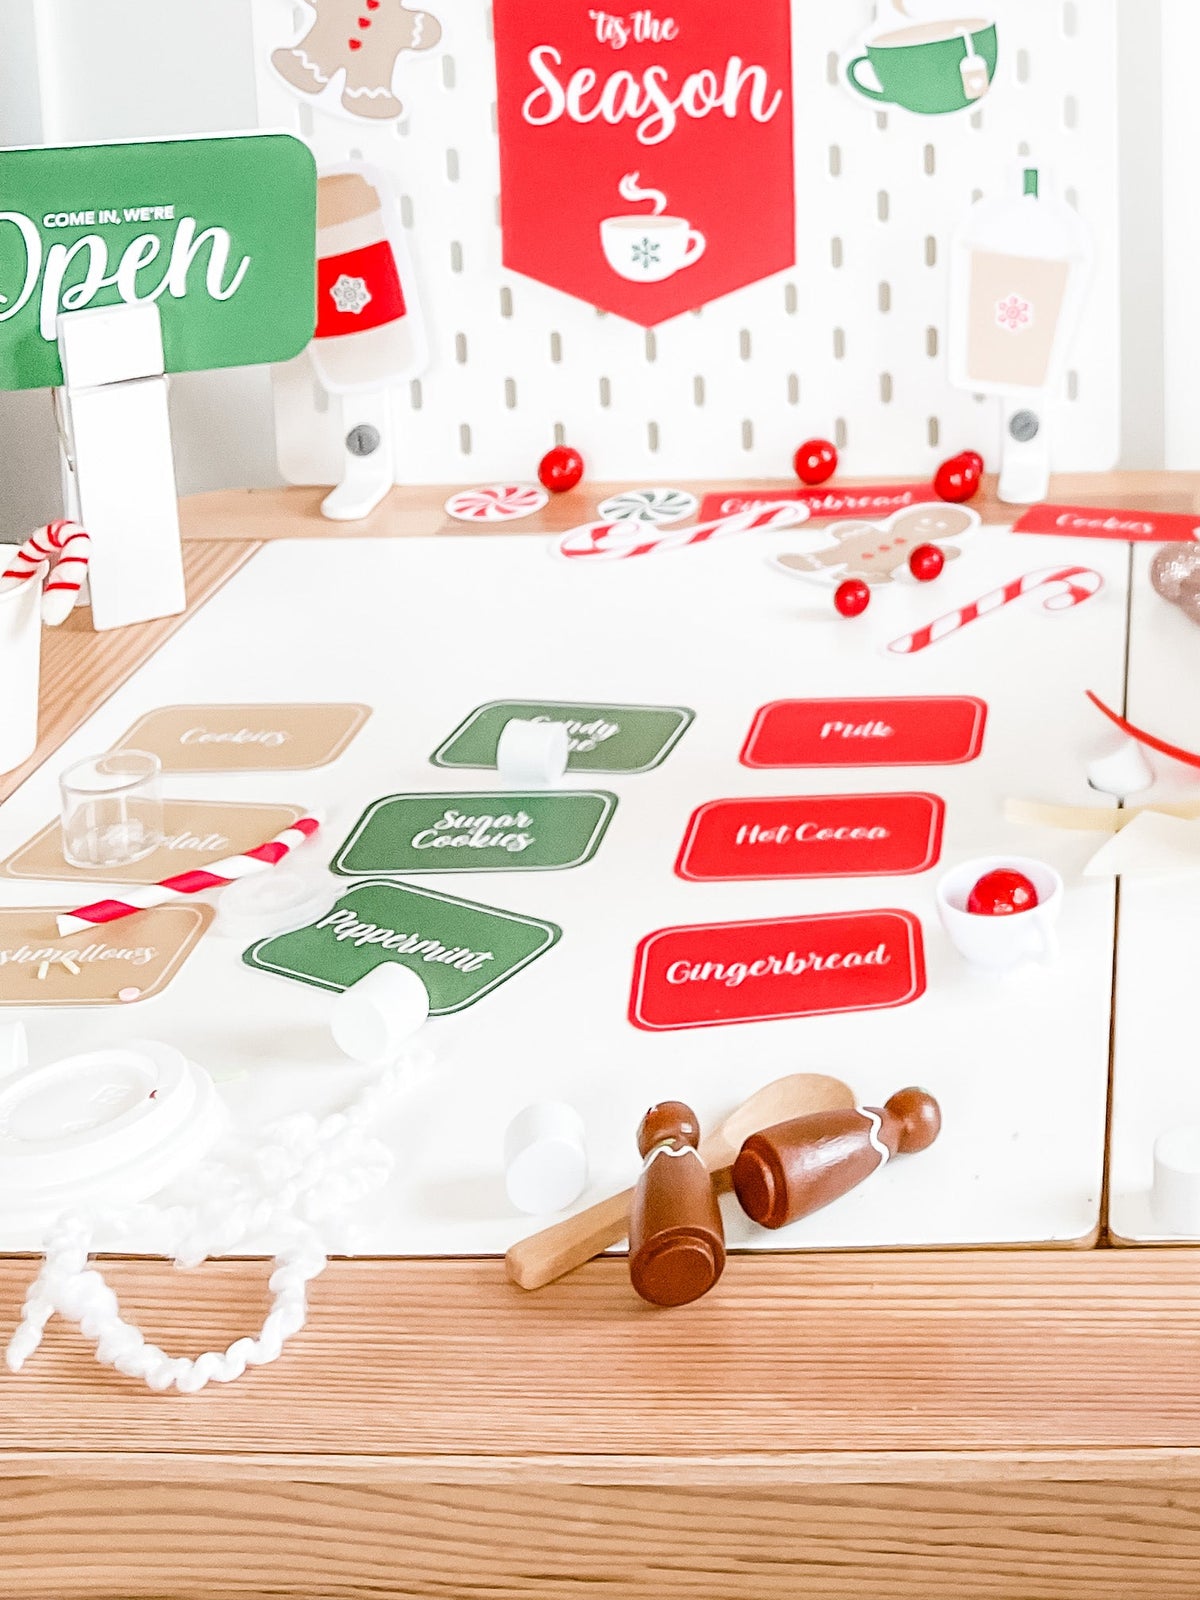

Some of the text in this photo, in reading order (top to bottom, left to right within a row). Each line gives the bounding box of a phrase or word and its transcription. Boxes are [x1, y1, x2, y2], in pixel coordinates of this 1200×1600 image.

[629, 9, 679, 43] the
[522, 45, 783, 145] Season
[43, 204, 176, 228] COME IN, WE'RE
[433, 809, 534, 835] Sugar
[735, 821, 891, 846] Hot Cocoa
[411, 827, 537, 853] Cookies
[318, 908, 495, 975] Peppermint
[666, 943, 891, 988] Gingerbread
